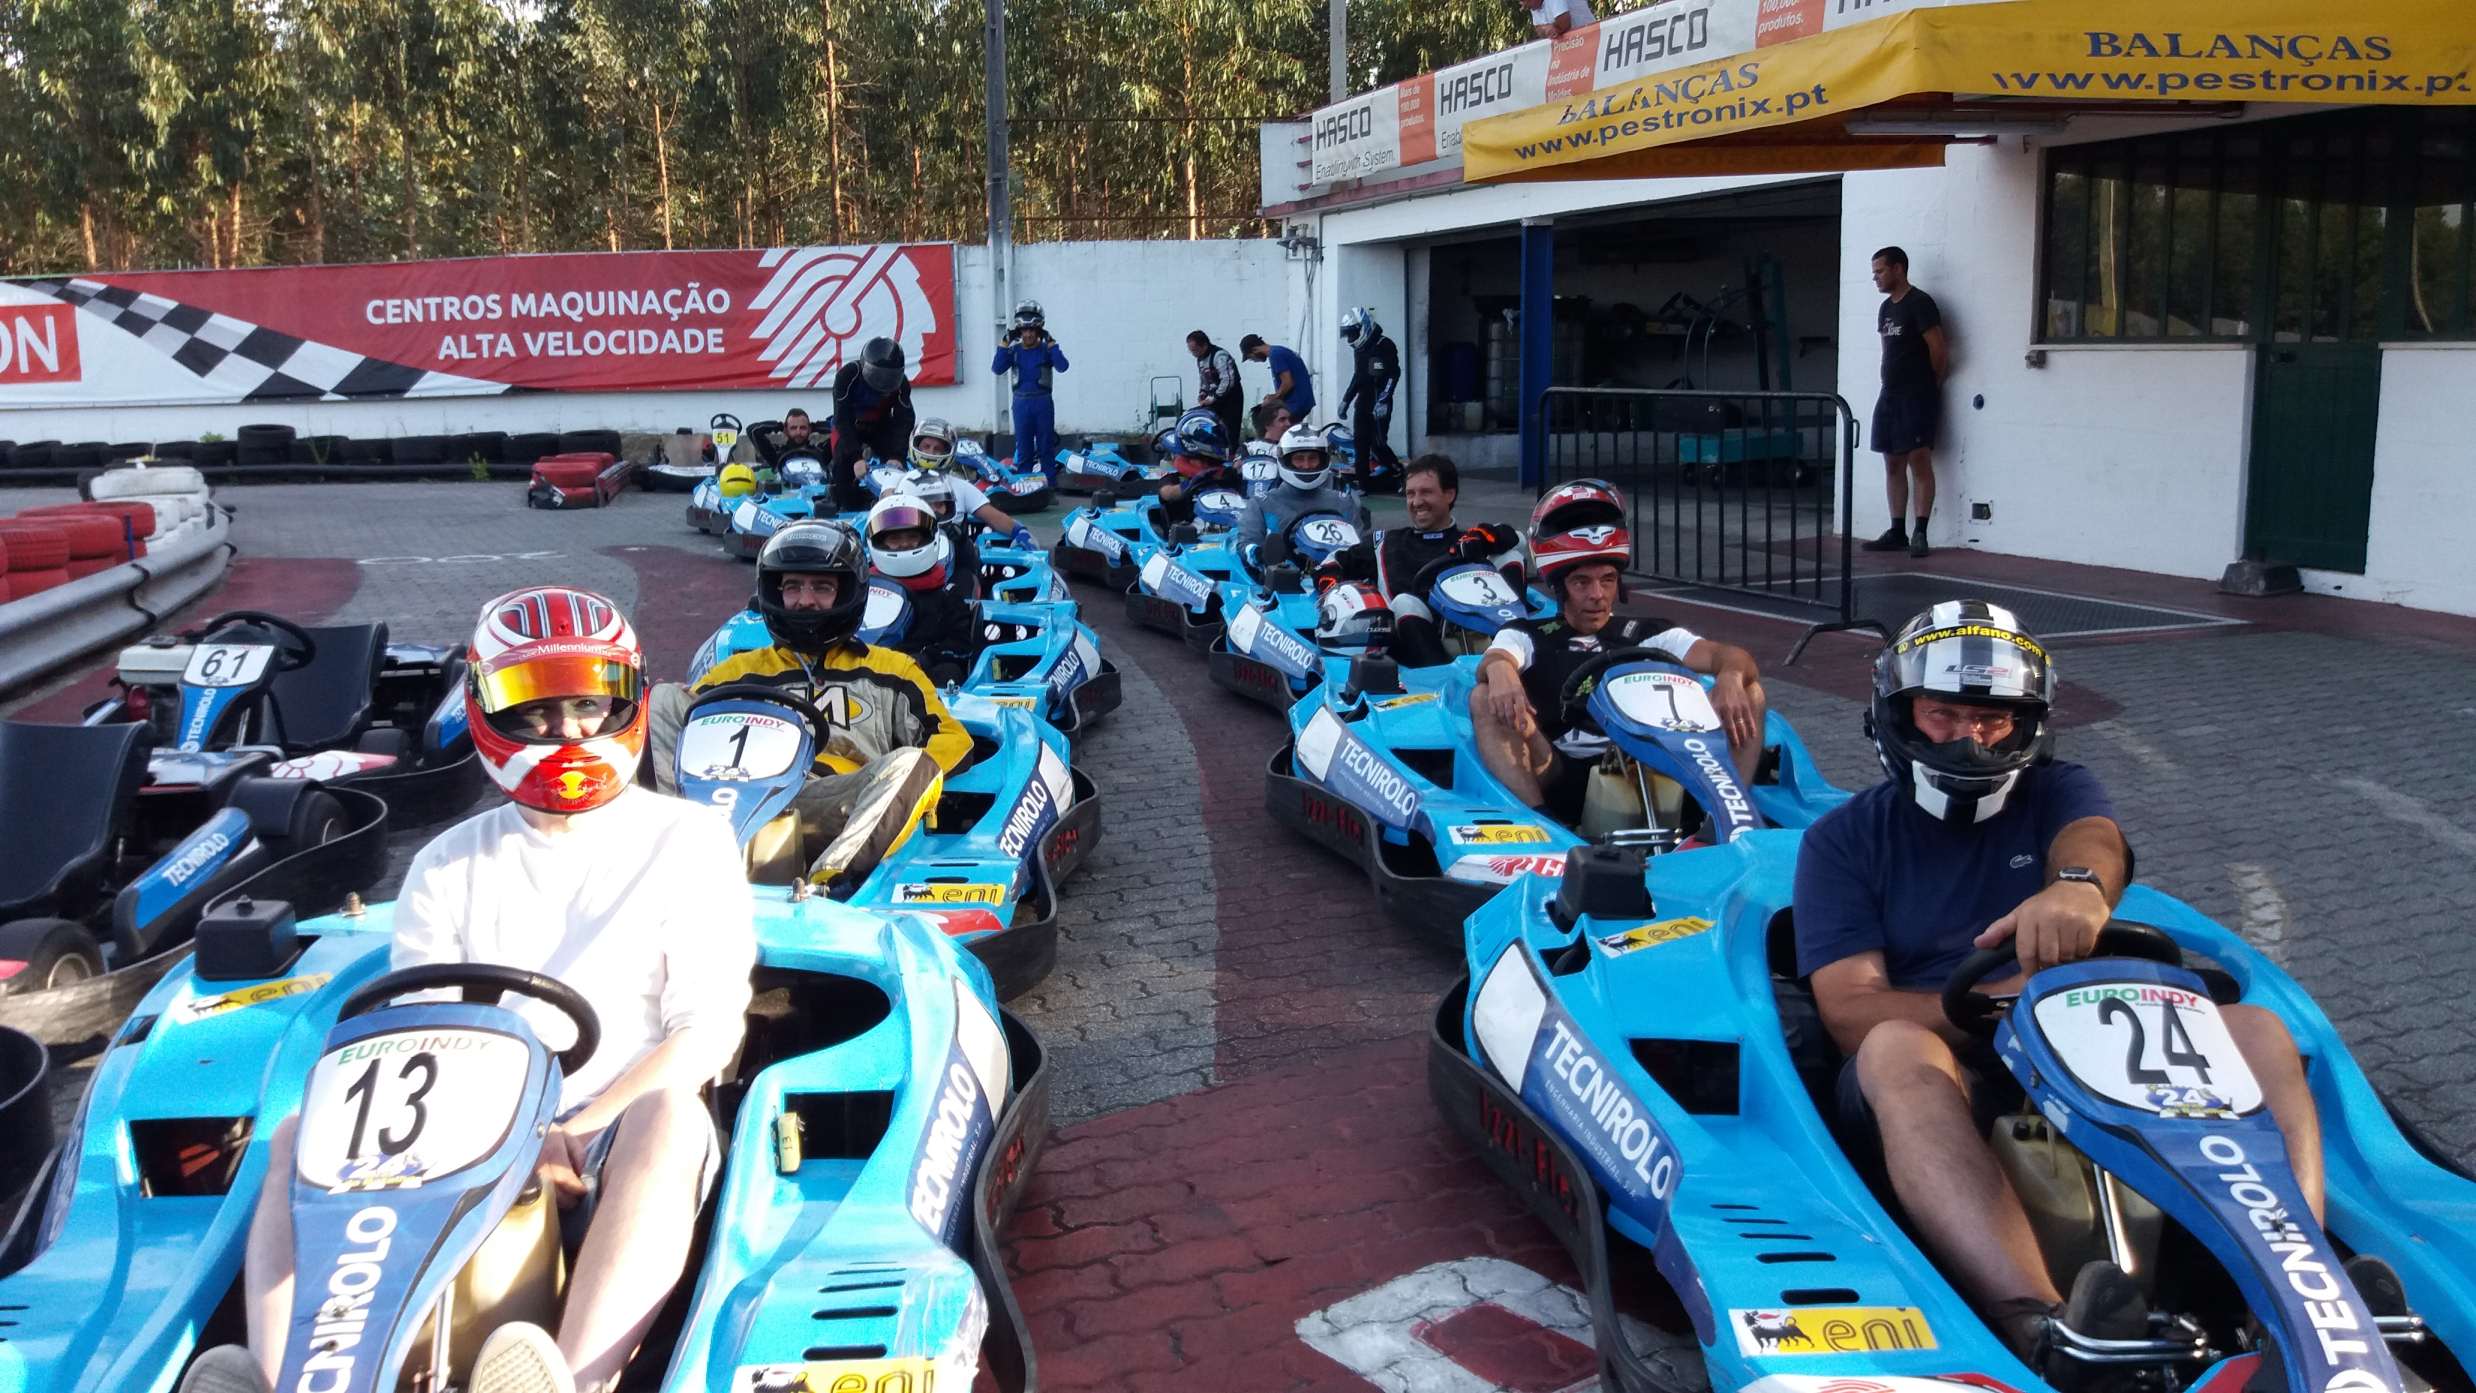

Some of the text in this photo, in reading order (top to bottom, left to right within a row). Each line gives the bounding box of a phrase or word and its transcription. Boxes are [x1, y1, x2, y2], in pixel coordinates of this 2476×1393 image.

[1604, 8, 1709, 72] HASCO
[1758, 12, 1803, 38] produtos.
[2084, 31, 2392, 66] BALANÇAS
[1440, 63, 1513, 116] HASCO
[1316, 105, 1371, 151] HASCO
[1513, 84, 1830, 160] www.pestronix.pt
[366, 282, 731, 325] CENTROS MAQUINAÇÃO
[438, 328, 725, 360] ALTA VELOCIDADE
[716, 432, 729, 444] 51
[1086, 460, 1119, 476] TECNIROLO
[1250, 463, 1266, 478] 17
[1219, 494, 1230, 507] 4
[1316, 523, 1343, 542] 26
[1167, 565, 1211, 600] TECNIROLO
[1474, 576, 1497, 601] 3
[1260, 622, 1314, 668] TECNIROLO
[1914, 625, 2042, 657] www.alfano.com
[201, 649, 250, 678] 61
[1623, 674, 1693, 687] EUROINDY
[1652, 684, 1683, 722] 7
[701, 715, 785, 729] EUROINDY
[729, 725, 750, 769] 1
[1339, 737, 1416, 816] TECNIROLO
[1684, 738, 1754, 826] TECNIROLO
[162, 833, 230, 888] TECNIROLO
[942, 884, 998, 904] eni
[2066, 988, 2198, 1008] EUROINDY
[338, 1037, 492, 1066] EUROINDY
[2098, 997, 2212, 1085] 24
[344, 1052, 438, 1160] 13
[1545, 1020, 1672, 1199] TECNIROLO
[2200, 1135, 2368, 1366] TECNIROLO
[1823, 1308, 1922, 1350] eni
